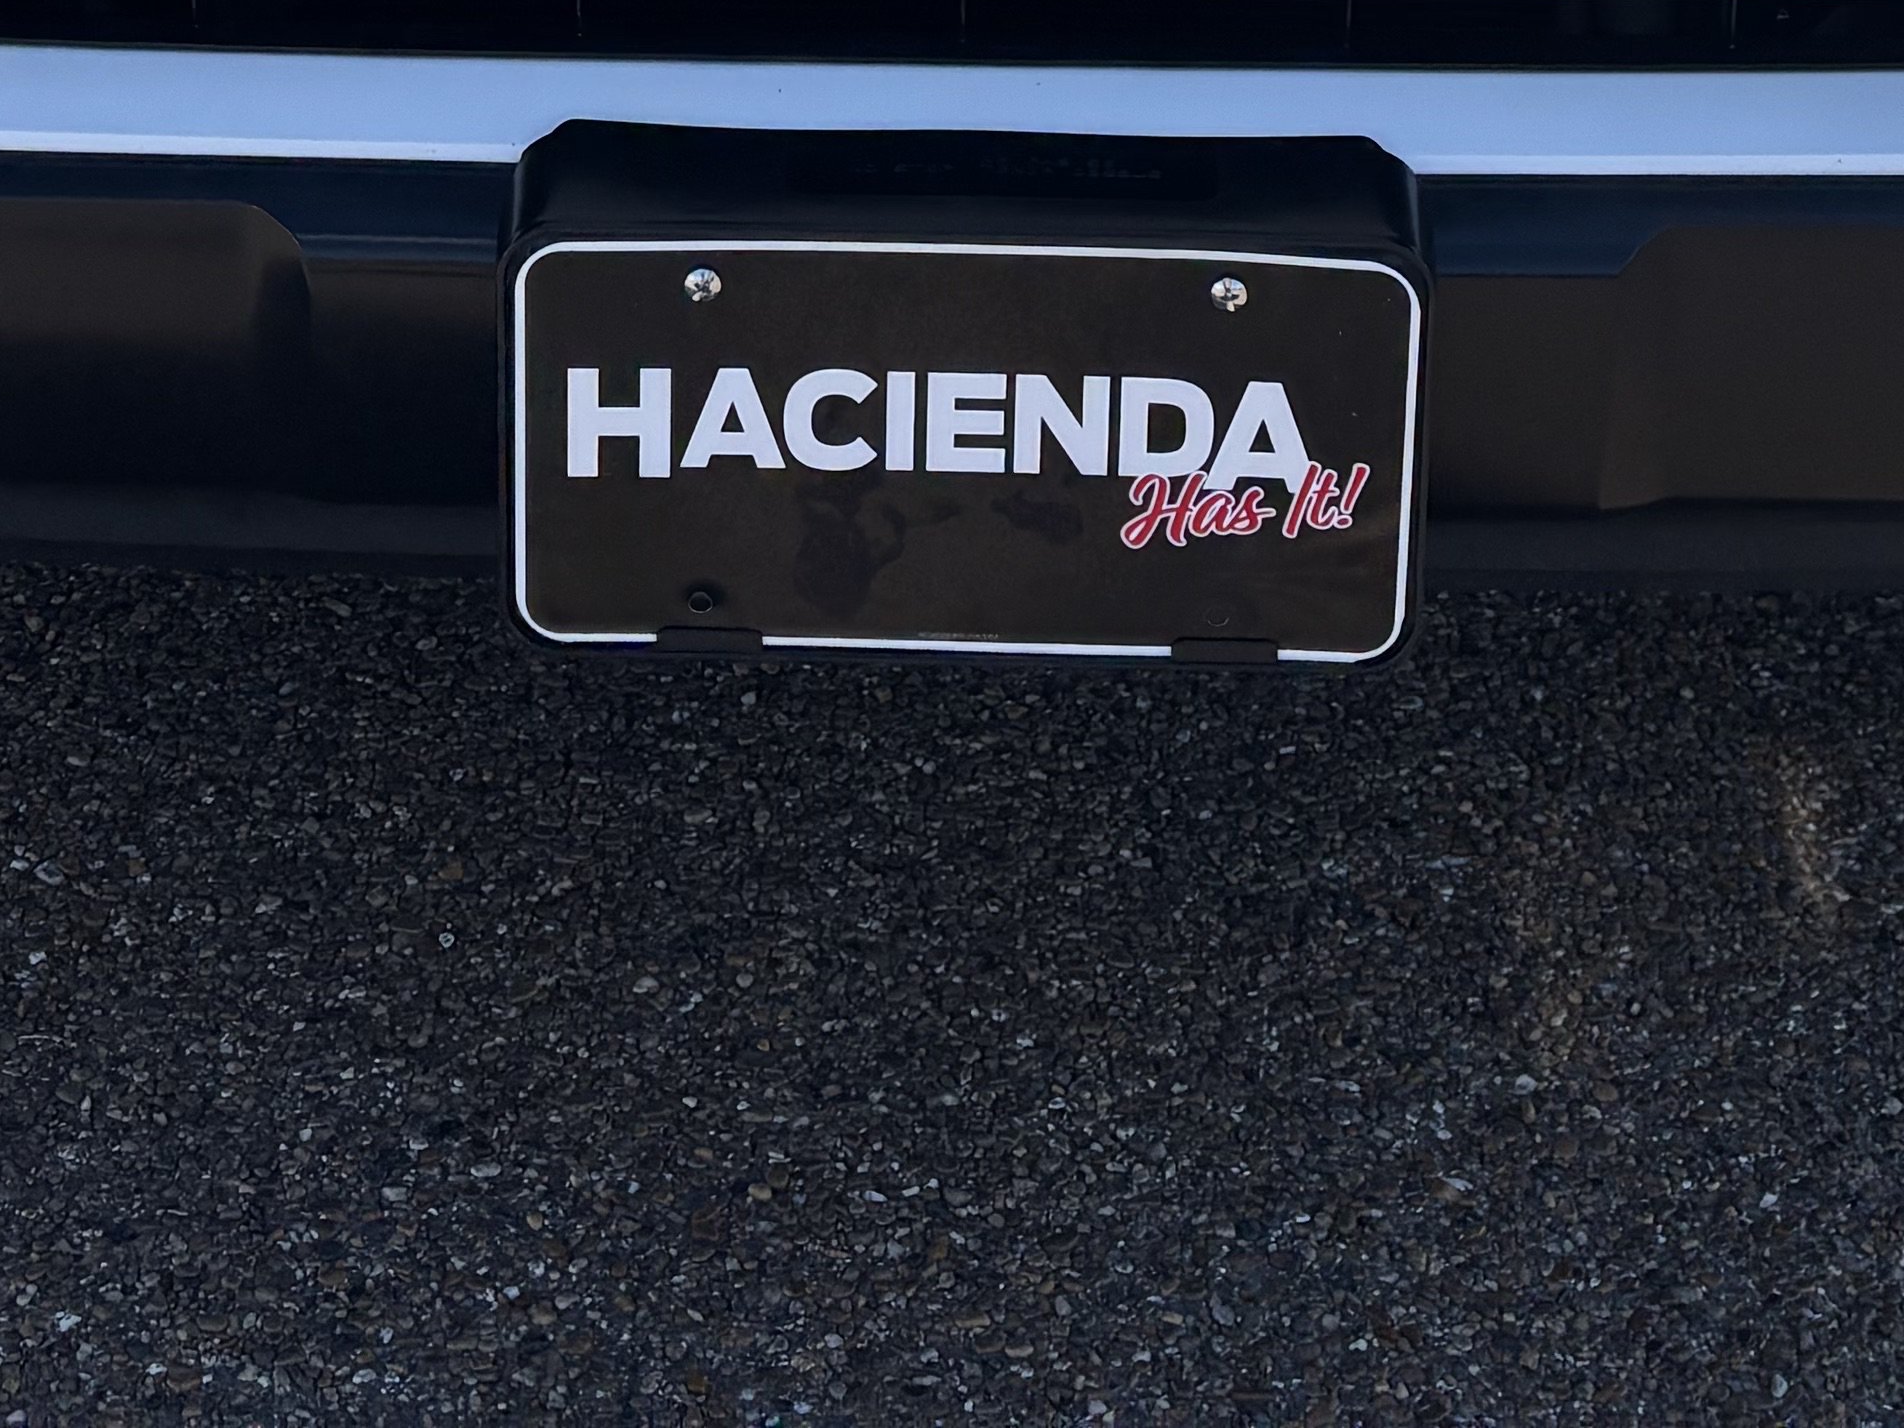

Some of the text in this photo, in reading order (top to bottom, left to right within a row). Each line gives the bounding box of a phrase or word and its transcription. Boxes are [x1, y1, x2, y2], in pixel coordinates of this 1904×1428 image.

[566, 366, 1314, 493] HACIENDA
[1120, 461, 1371, 549] Has It!
